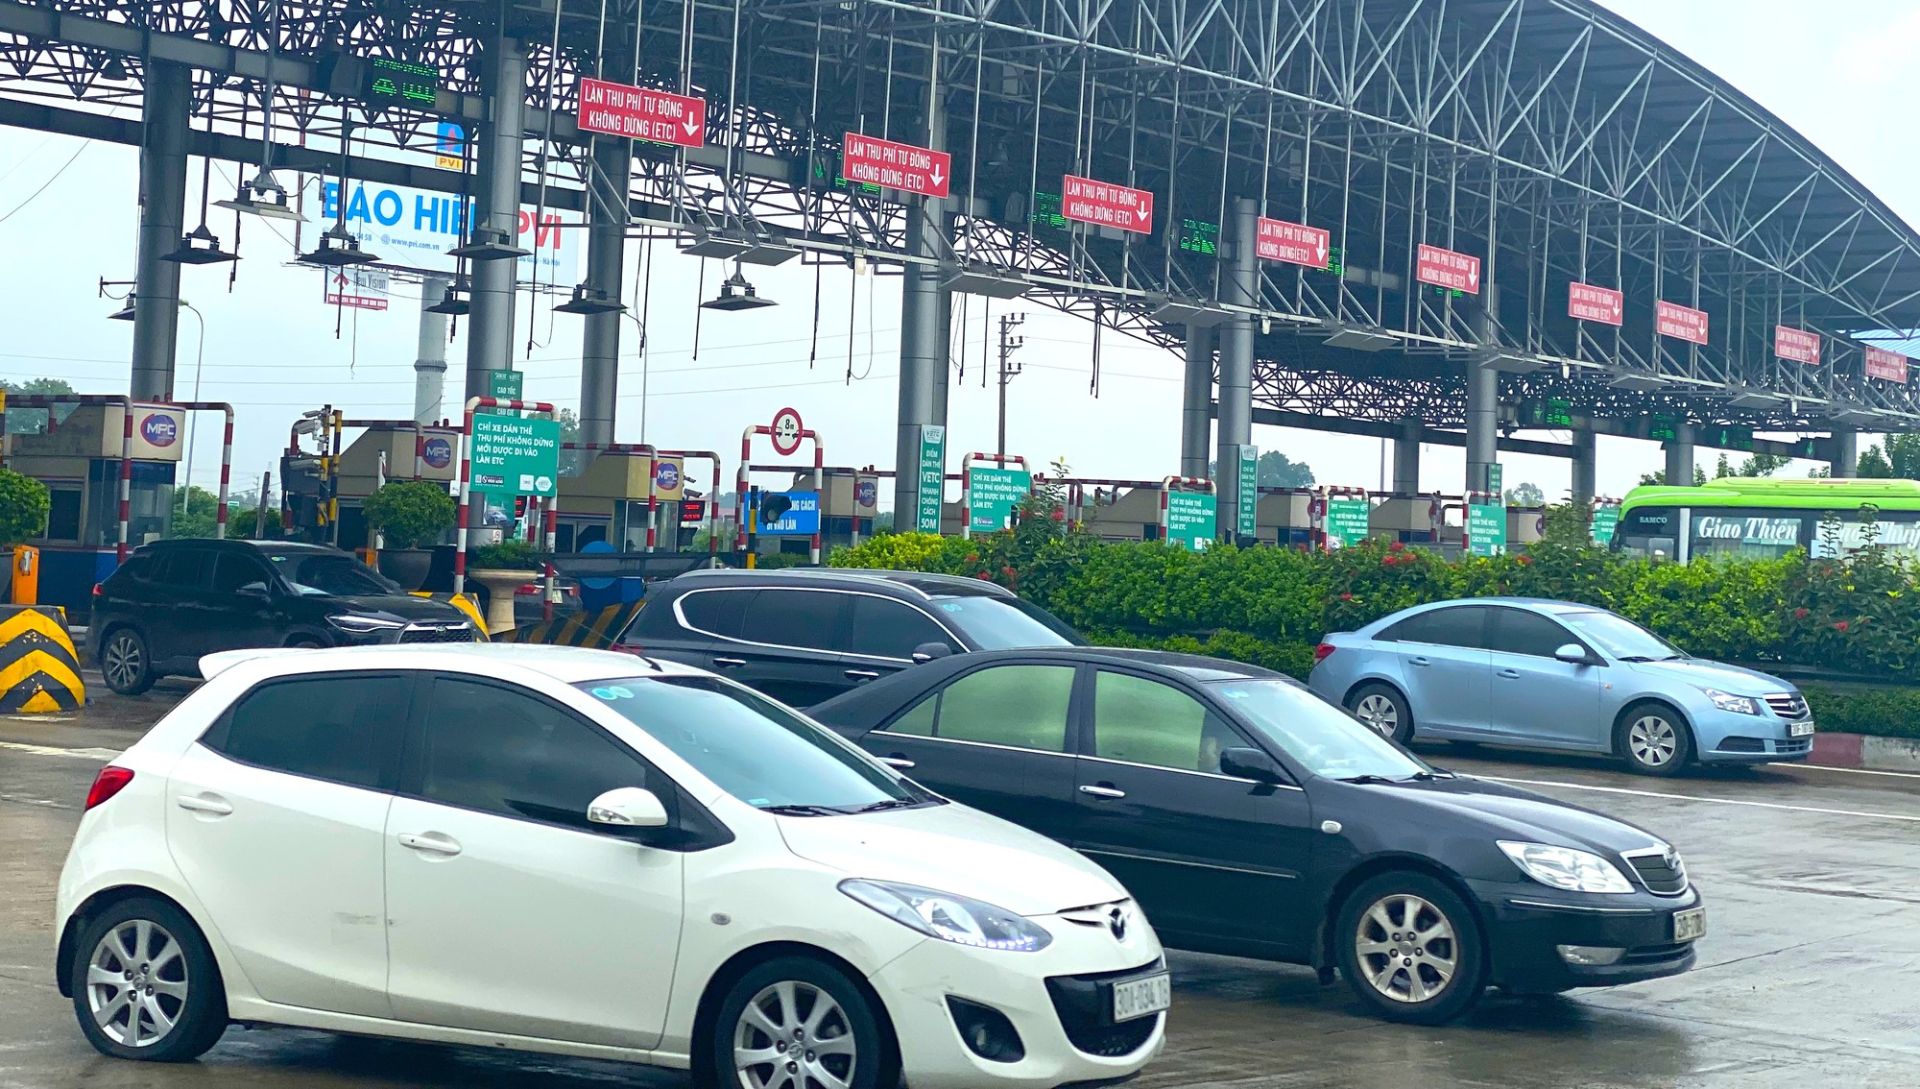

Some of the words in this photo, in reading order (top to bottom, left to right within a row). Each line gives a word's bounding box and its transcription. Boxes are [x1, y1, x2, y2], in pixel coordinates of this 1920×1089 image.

[585, 82, 603, 104] LÀN
[606, 88, 624, 108] THU
[626, 91, 643, 111] PHÍ
[644, 96, 656, 117] TỰ
[658, 97, 683, 119] ĐỘNG
[589, 109, 621, 131] KHÔNG
[623, 113, 649, 136] DỪNG
[652, 122, 676, 141] (ETC)
[848, 137, 864, 159] LÀN
[866, 143, 881, 160] THU
[883, 145, 897, 163] PHÍ
[909, 150, 931, 171] ĐỘNG
[440, 157, 460, 168] PVI
[852, 161, 879, 181] KHÔNG
[881, 165, 903, 186] DỪNG
[904, 172, 925, 190] (ETC)
[518, 209, 562, 250] PVI
[391, 238, 440, 251] www.pvi.com.vn
[147, 422, 175, 436] MPC
[477, 421, 491, 432] CHỈ
[492, 424, 502, 433] XE
[502, 423, 518, 434] DÁN
[477, 433, 492, 443] THU
[493, 434, 506, 444] PHÍ
[506, 436, 532, 446] KHÔNG
[426, 446, 450, 458] MPC
[523, 447, 539, 457] VÀO
[475, 454, 490, 464] LÀN
[491, 456, 505, 465] ETC
[657, 470, 678, 480] MPC
[922, 471, 940, 484] VETC
[800, 497, 816, 511] CÁCH
[785, 516, 797, 530] LÀN
[921, 518, 937, 529] 50M
[1698, 516, 1742, 539] Giao
